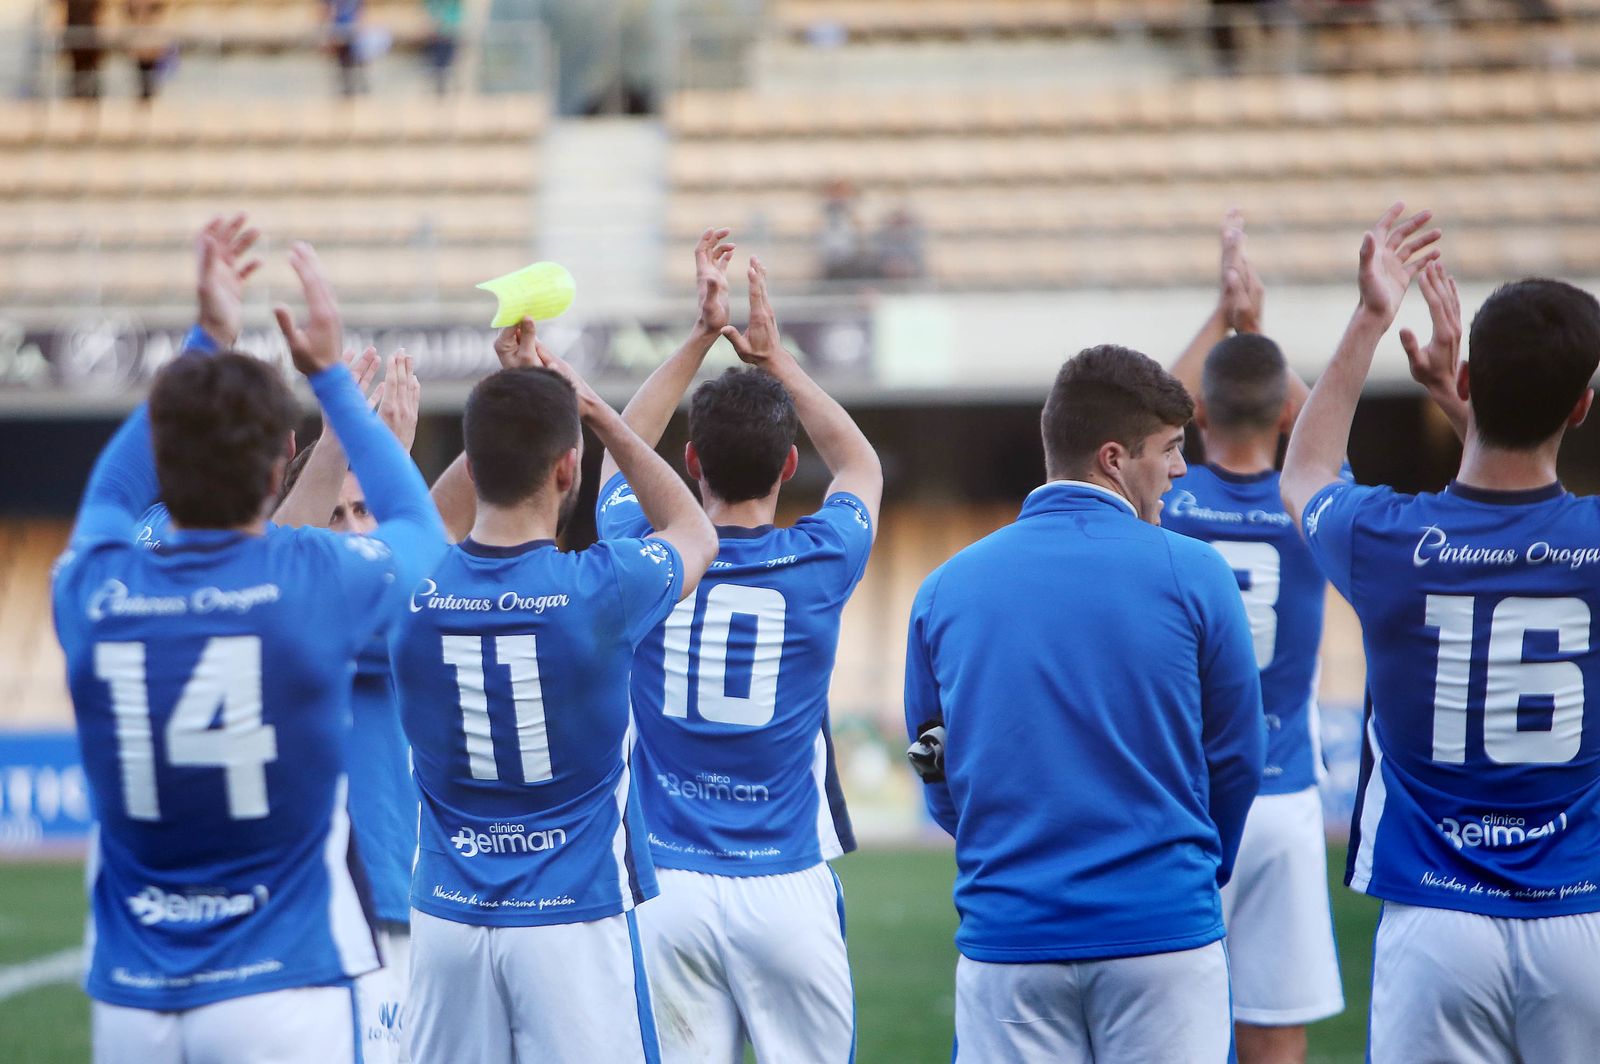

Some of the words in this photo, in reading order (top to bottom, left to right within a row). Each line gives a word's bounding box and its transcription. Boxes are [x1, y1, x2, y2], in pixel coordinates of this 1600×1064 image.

[1413, 523, 1518, 568] Pinturas
[1526, 541, 1600, 570] Oroga
[409, 578, 493, 613] Pinturas
[498, 591, 570, 614] Orogar
[663, 583, 787, 726] 10
[1424, 594, 1592, 765] 16
[93, 635, 278, 821] 14
[441, 634, 554, 783] 11
[451, 826, 567, 857] Beiman
[432, 884, 467, 904] Nacidos
[467, 893, 477, 905] de
[1420, 871, 1467, 892] Nacidos
[1470, 881, 1484, 895] de
